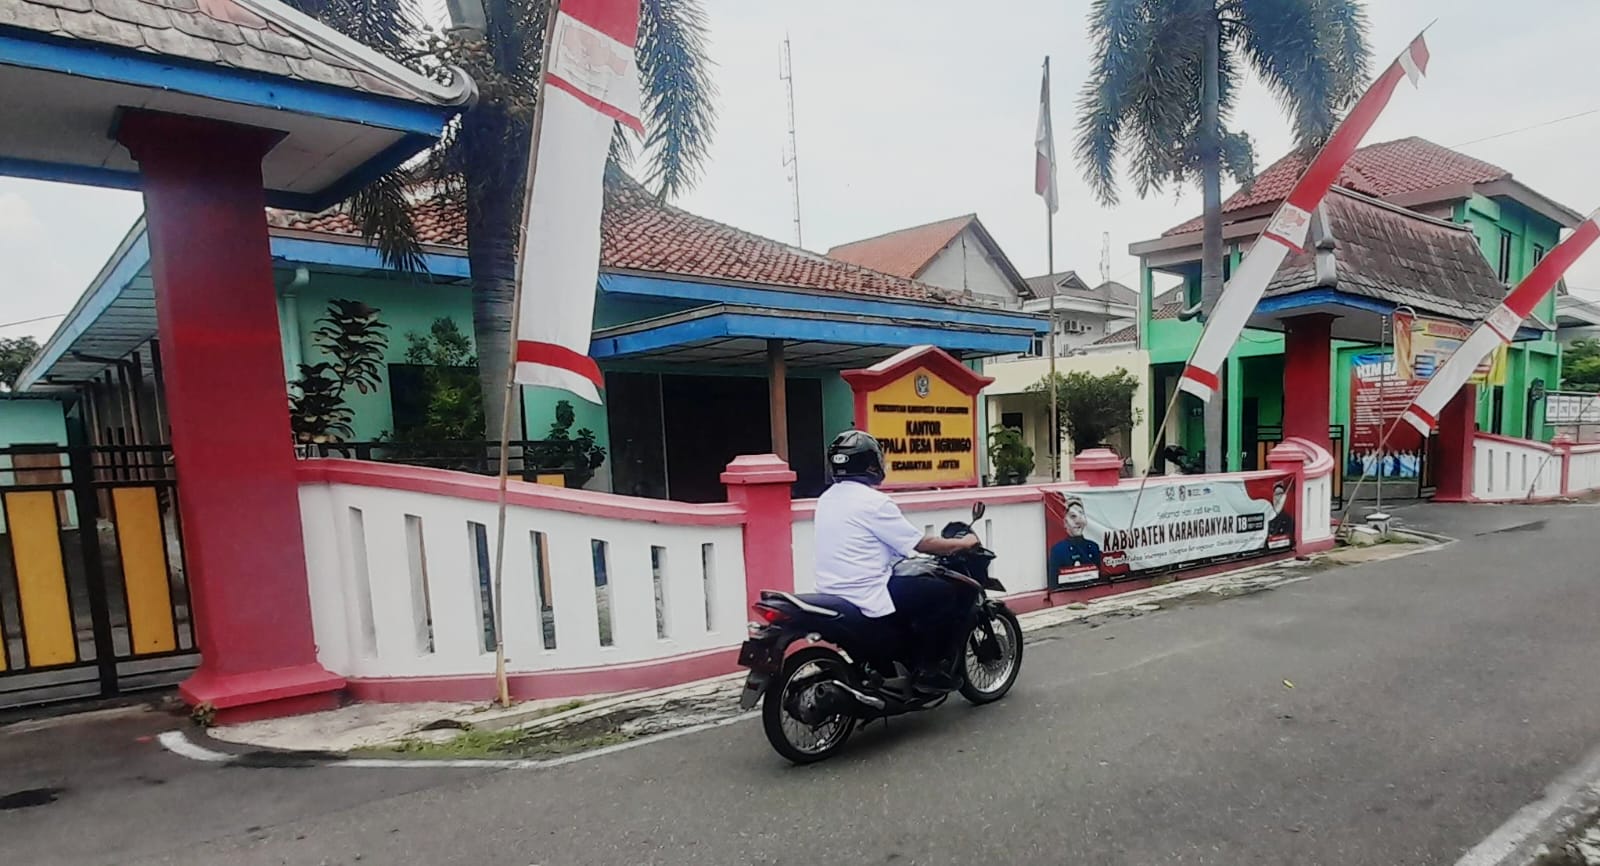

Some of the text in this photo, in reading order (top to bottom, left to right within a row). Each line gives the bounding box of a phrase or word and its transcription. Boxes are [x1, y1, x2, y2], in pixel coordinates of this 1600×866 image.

[906, 420, 941, 436] KANTOR
[876, 437, 971, 454] EPALA DESA NGRINGO
[937, 459, 960, 470] JATEN
[1103, 526, 1165, 552] KABUPATEN
[1168, 515, 1234, 542] KARANGANYAR
[1238, 517, 1248, 531] 18
